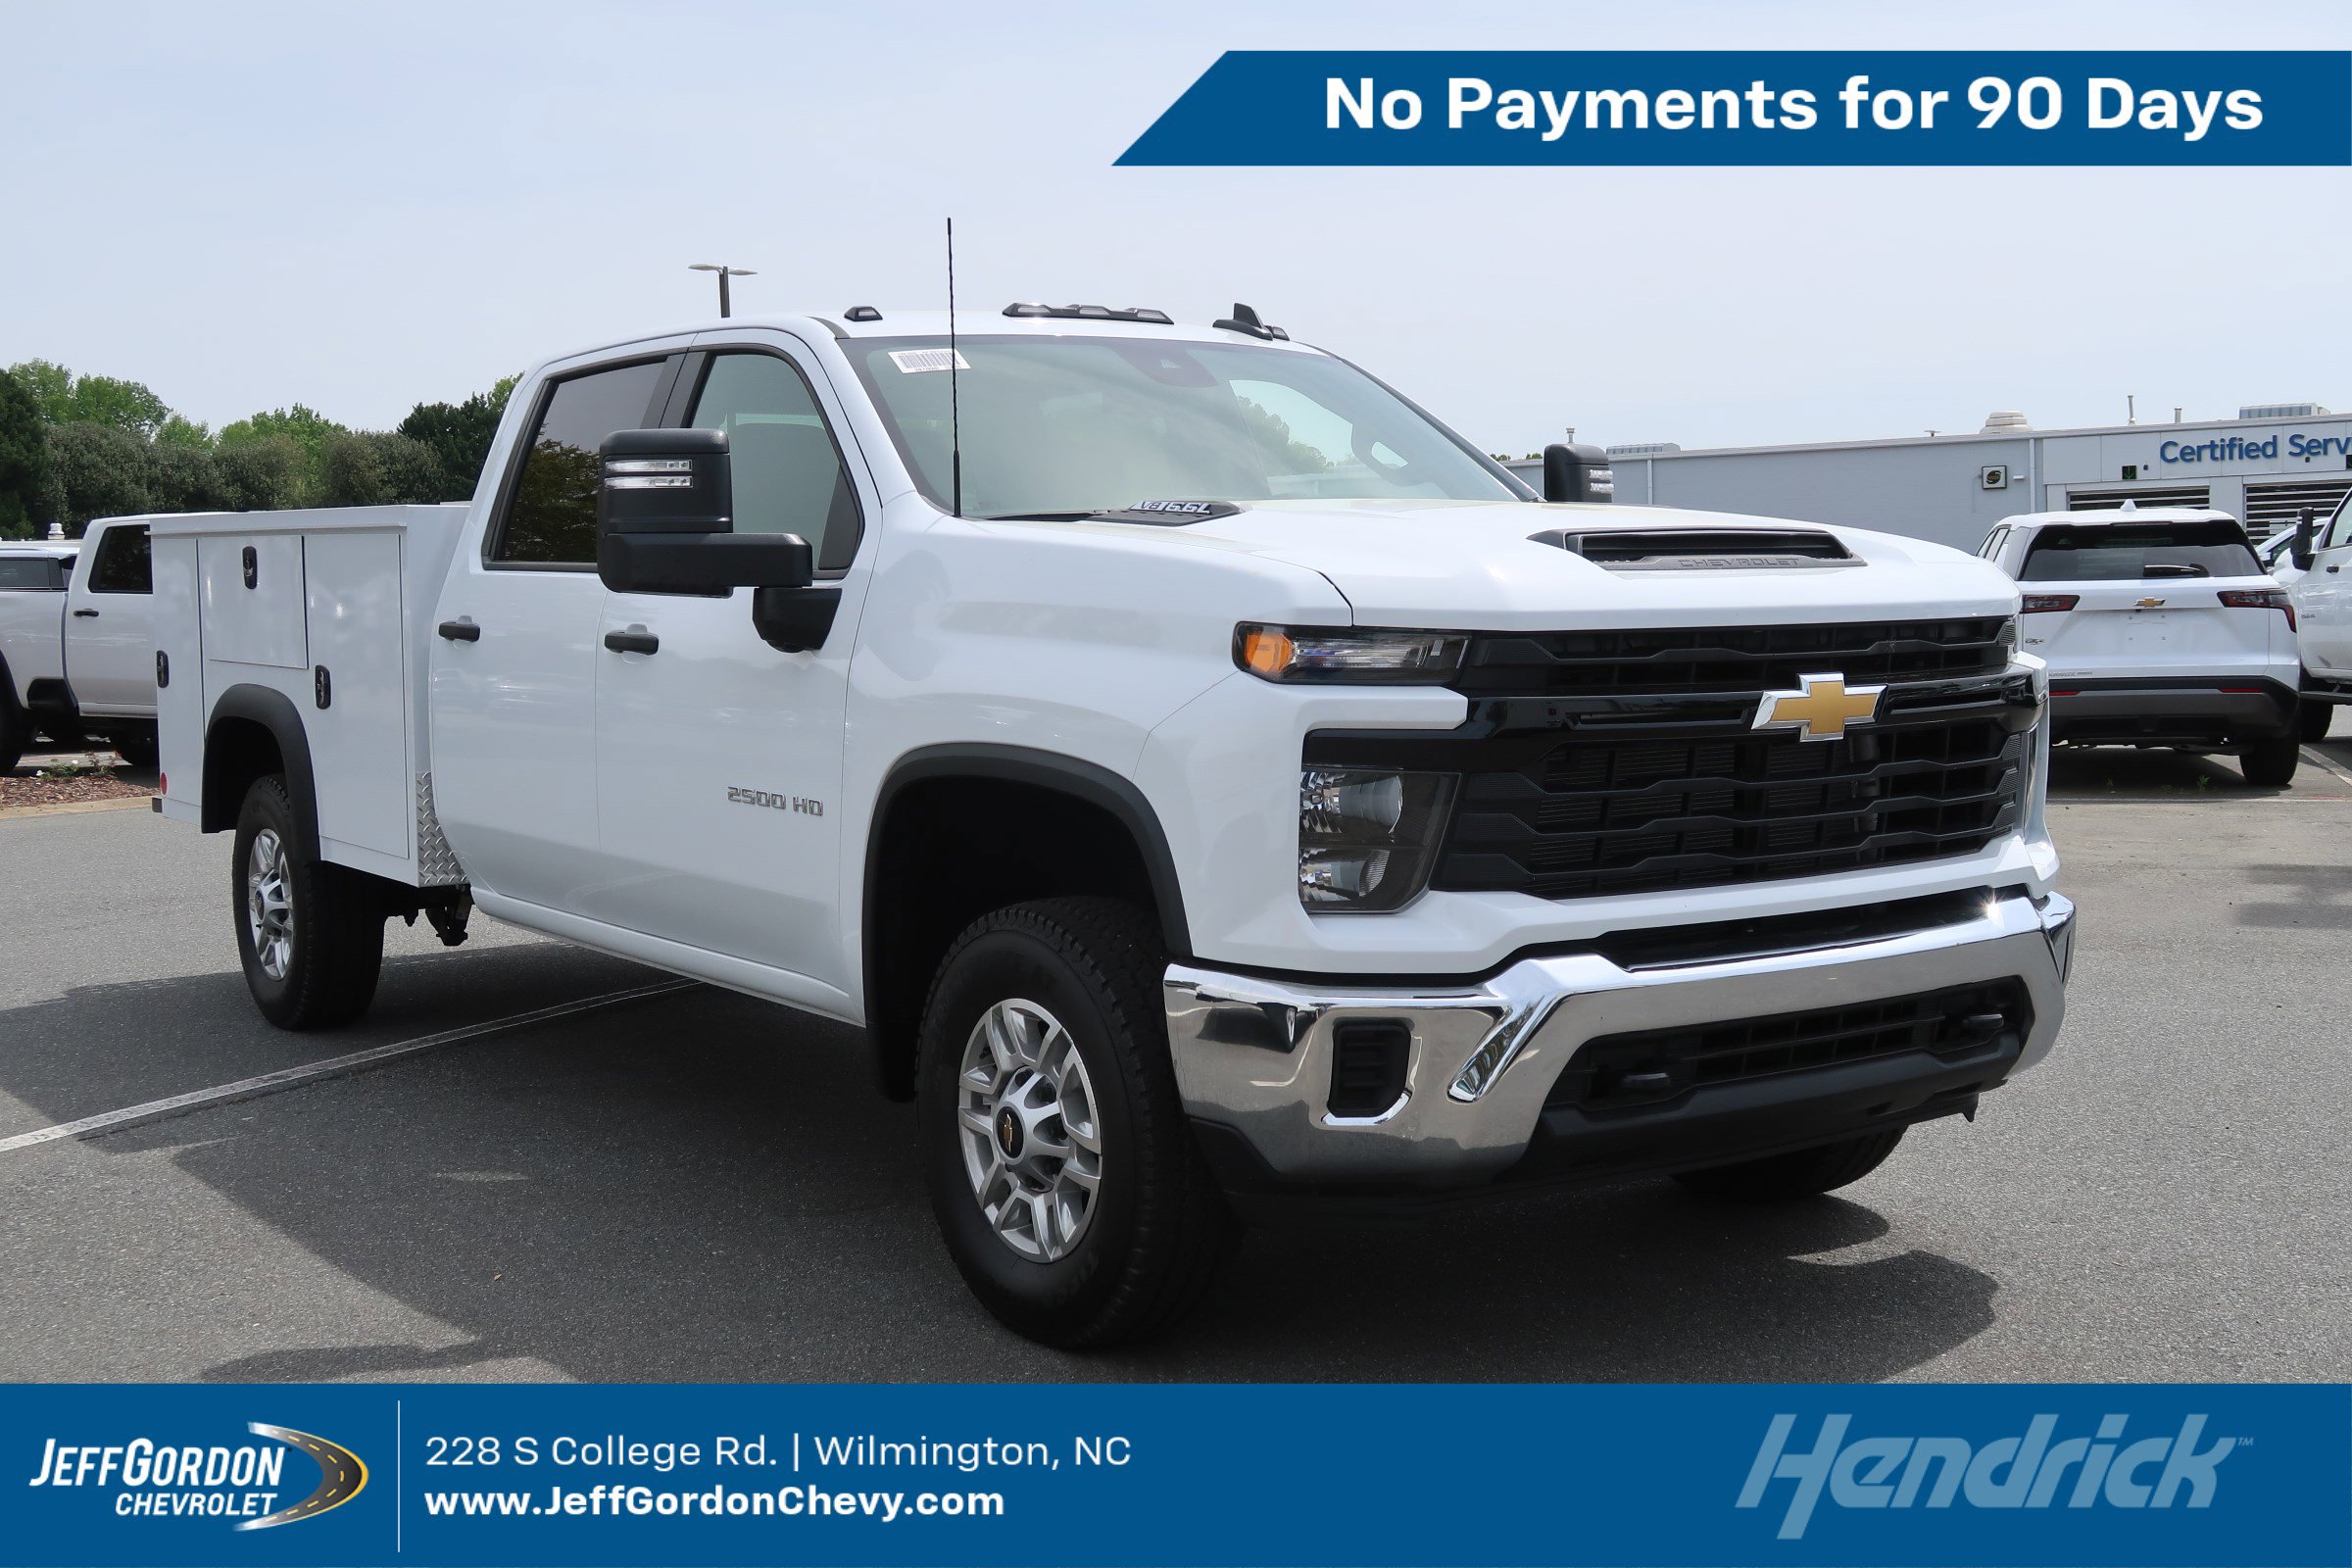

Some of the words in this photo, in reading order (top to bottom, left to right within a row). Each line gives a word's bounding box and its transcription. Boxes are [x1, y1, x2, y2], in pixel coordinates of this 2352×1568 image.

[2159, 434, 2278, 465] Certified
[1677, 557, 1800, 567] CHEVROLET
[727, 786, 786, 810] 2500
[792, 796, 824, 816] HD
